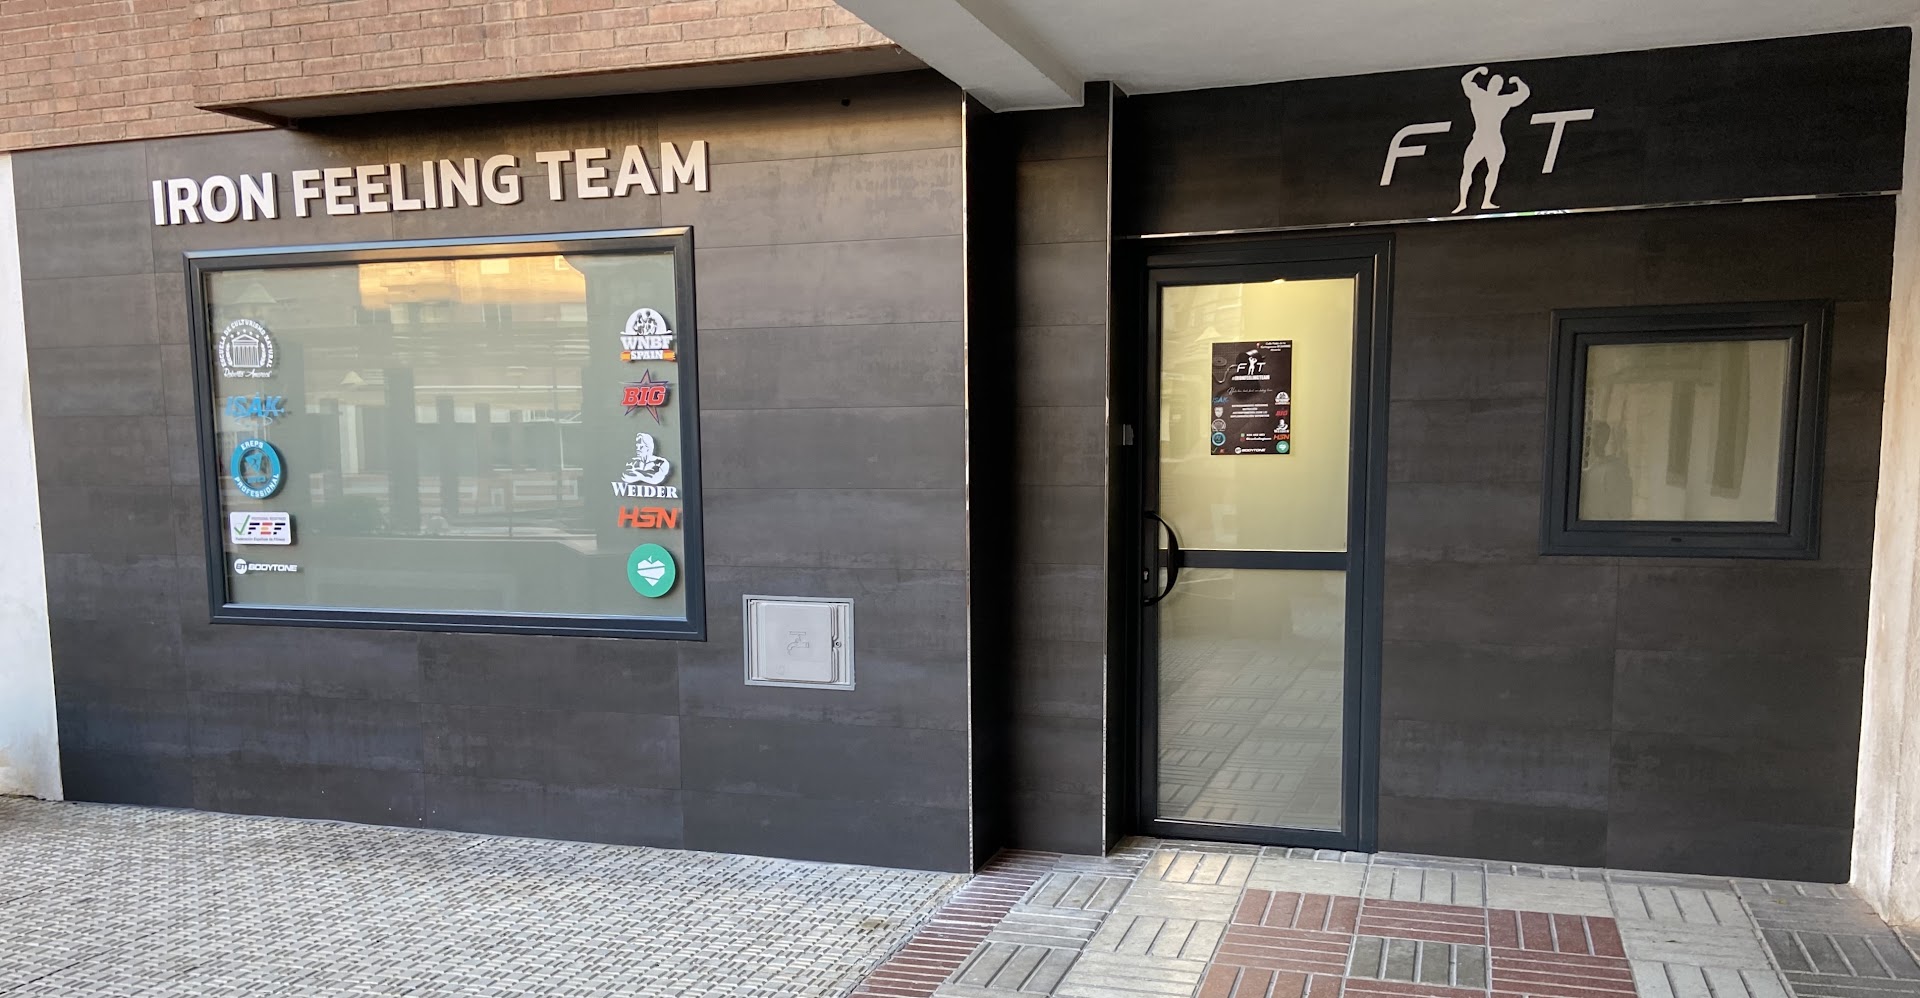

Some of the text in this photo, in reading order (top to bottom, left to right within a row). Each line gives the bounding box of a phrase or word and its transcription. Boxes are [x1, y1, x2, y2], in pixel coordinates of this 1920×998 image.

[152, 140, 711, 226] IRON FEELING TEAM
[219, 319, 274, 368] ESCUELA DE CULTURISMO NATURAL
[620, 335, 673, 350] WNBF
[630, 350, 664, 360] SPAIN
[621, 385, 666, 406] BIG
[225, 394, 282, 417] ISAK
[240, 440, 264, 451] EREPS
[234, 474, 279, 498] PROFESSIONAL
[611, 481, 678, 499] WEIDER
[617, 505, 679, 529] HSN
[248, 522, 286, 535] FEF
[248, 563, 298, 572] BODYTONE
